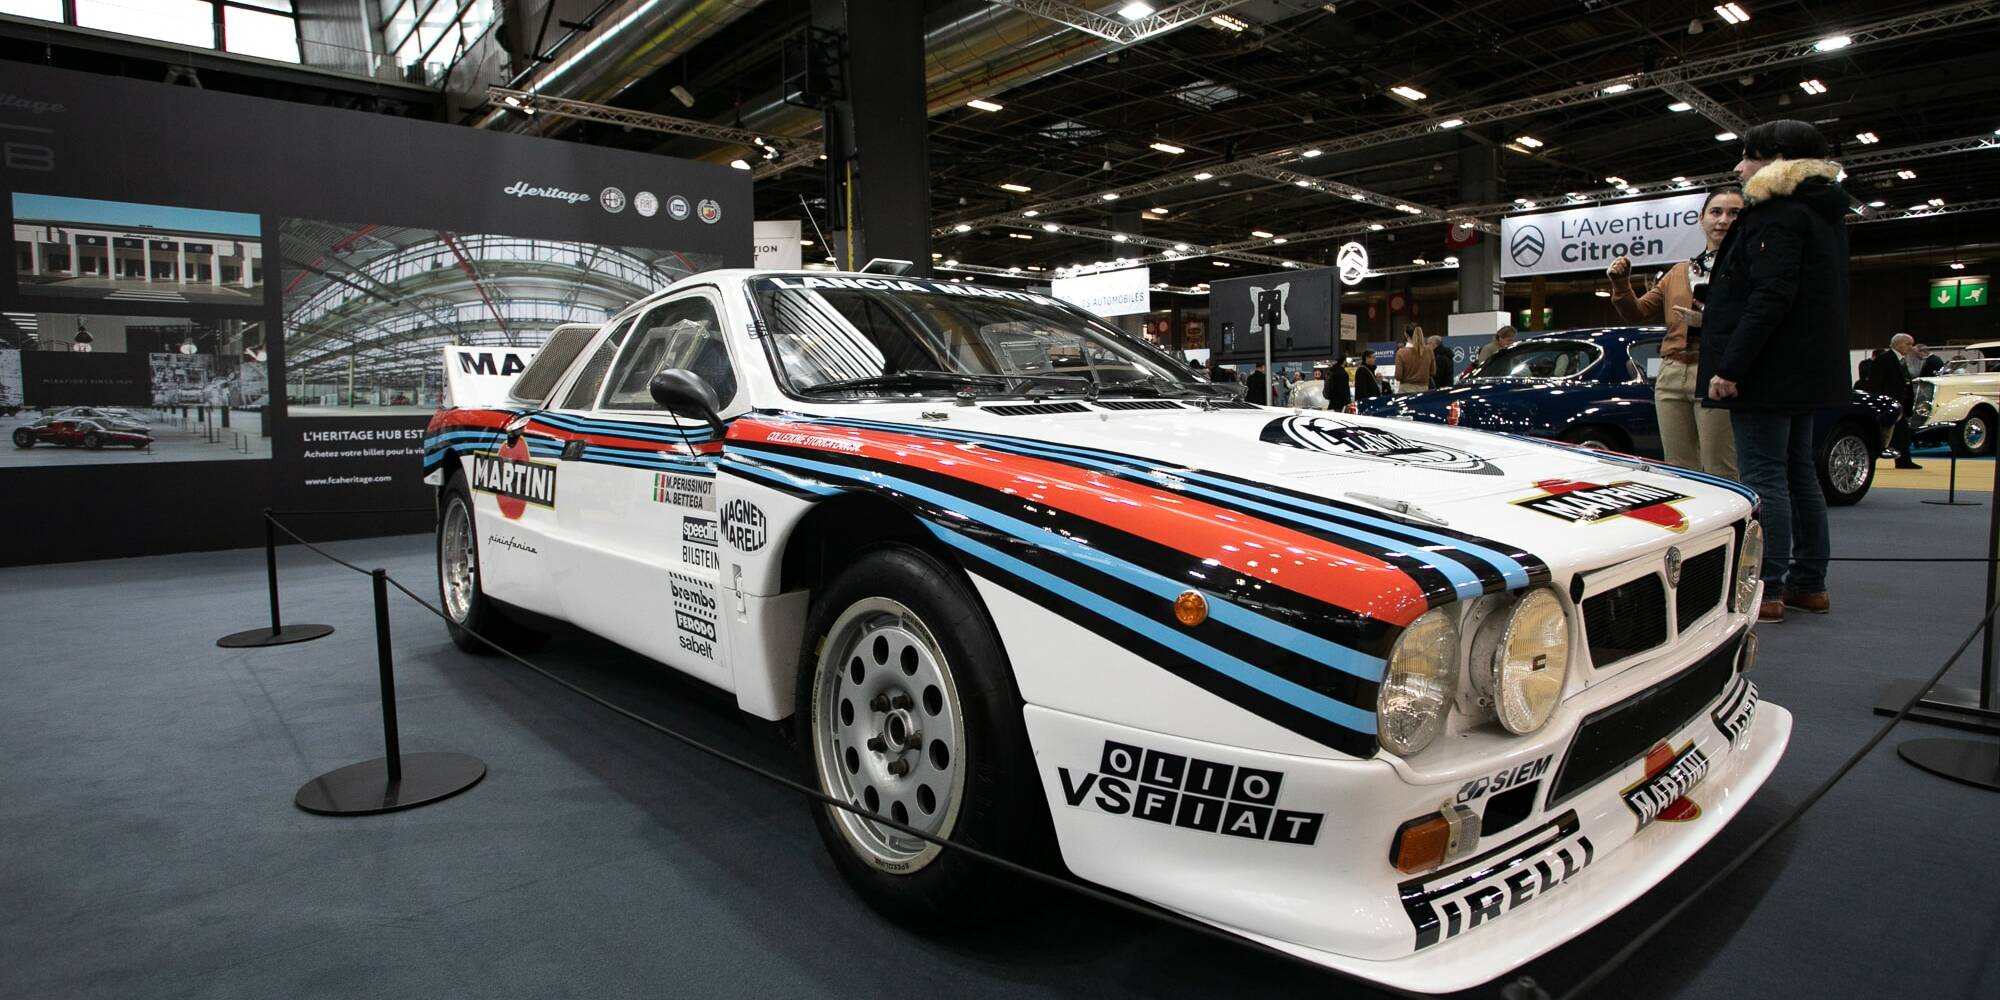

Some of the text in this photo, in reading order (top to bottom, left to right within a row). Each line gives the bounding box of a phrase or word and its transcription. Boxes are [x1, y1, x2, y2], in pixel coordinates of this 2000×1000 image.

[504, 181, 592, 204] Heritage
[1561, 208, 1699, 239] L'Aventure
[1561, 236, 1663, 263] Citroën
[769, 276, 930, 292] LANCIA
[303, 429, 425, 442] L'HERITAGE HUB EST
[304, 450, 339, 458] Achetez
[363, 448, 385, 456] billet
[386, 449, 404, 457] pour
[305, 475, 392, 486] www.fcaheritage.com
[474, 457, 554, 502] MARTINI
[673, 492, 703, 509] BETTEGA
[1532, 483, 1675, 518] MARTINI
[488, 534, 538, 554] pininfarina
[683, 545, 720, 570] BILSTEIN
[670, 580, 716, 610] brembo
[680, 617, 714, 638] FERODO
[679, 635, 714, 660] sabelt
[1107, 746, 1272, 801] OLIO
[1489, 754, 1553, 793] SIEM
[1630, 748, 1710, 824] MARTINI
[1141, 791, 1313, 841] FIAT
[1398, 808, 1594, 952] PIRELLI
